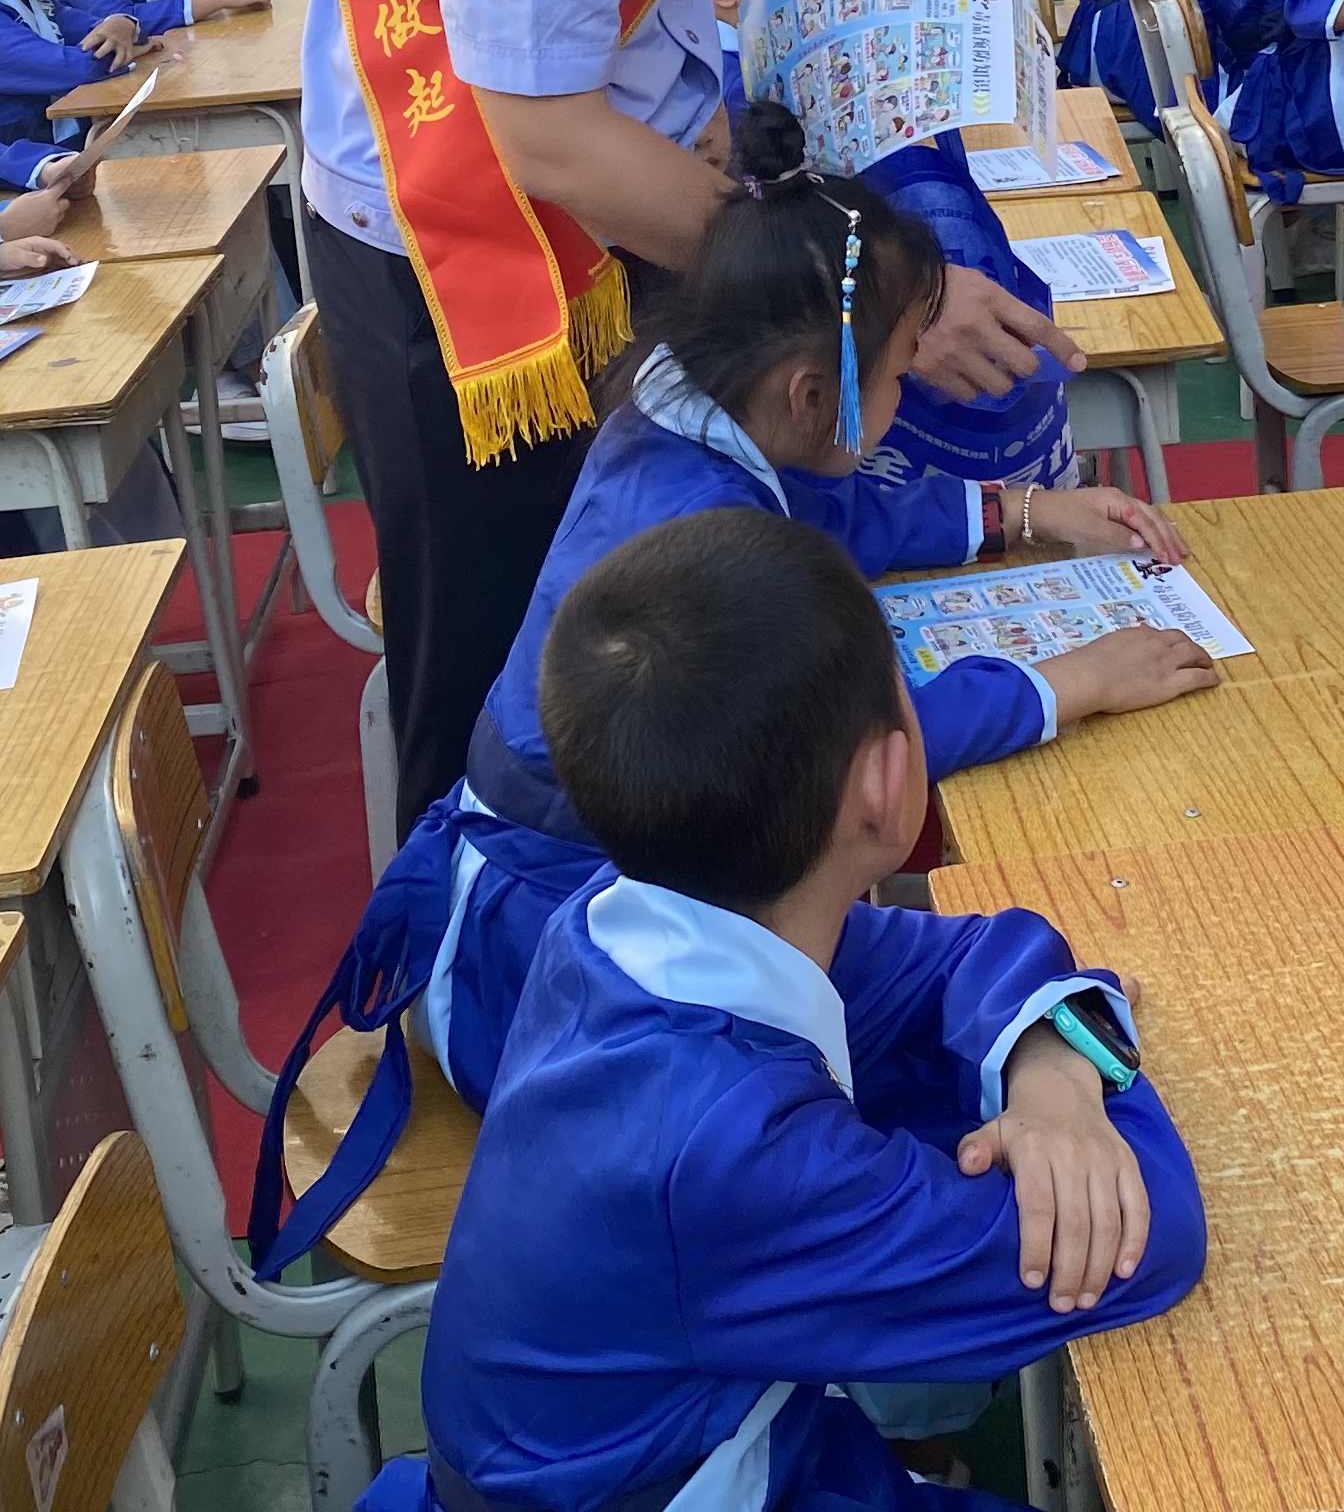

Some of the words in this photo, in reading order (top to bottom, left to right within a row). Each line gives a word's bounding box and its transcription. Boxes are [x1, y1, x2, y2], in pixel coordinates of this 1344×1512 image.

[971, 11, 992, 94] 毒品预防知识
